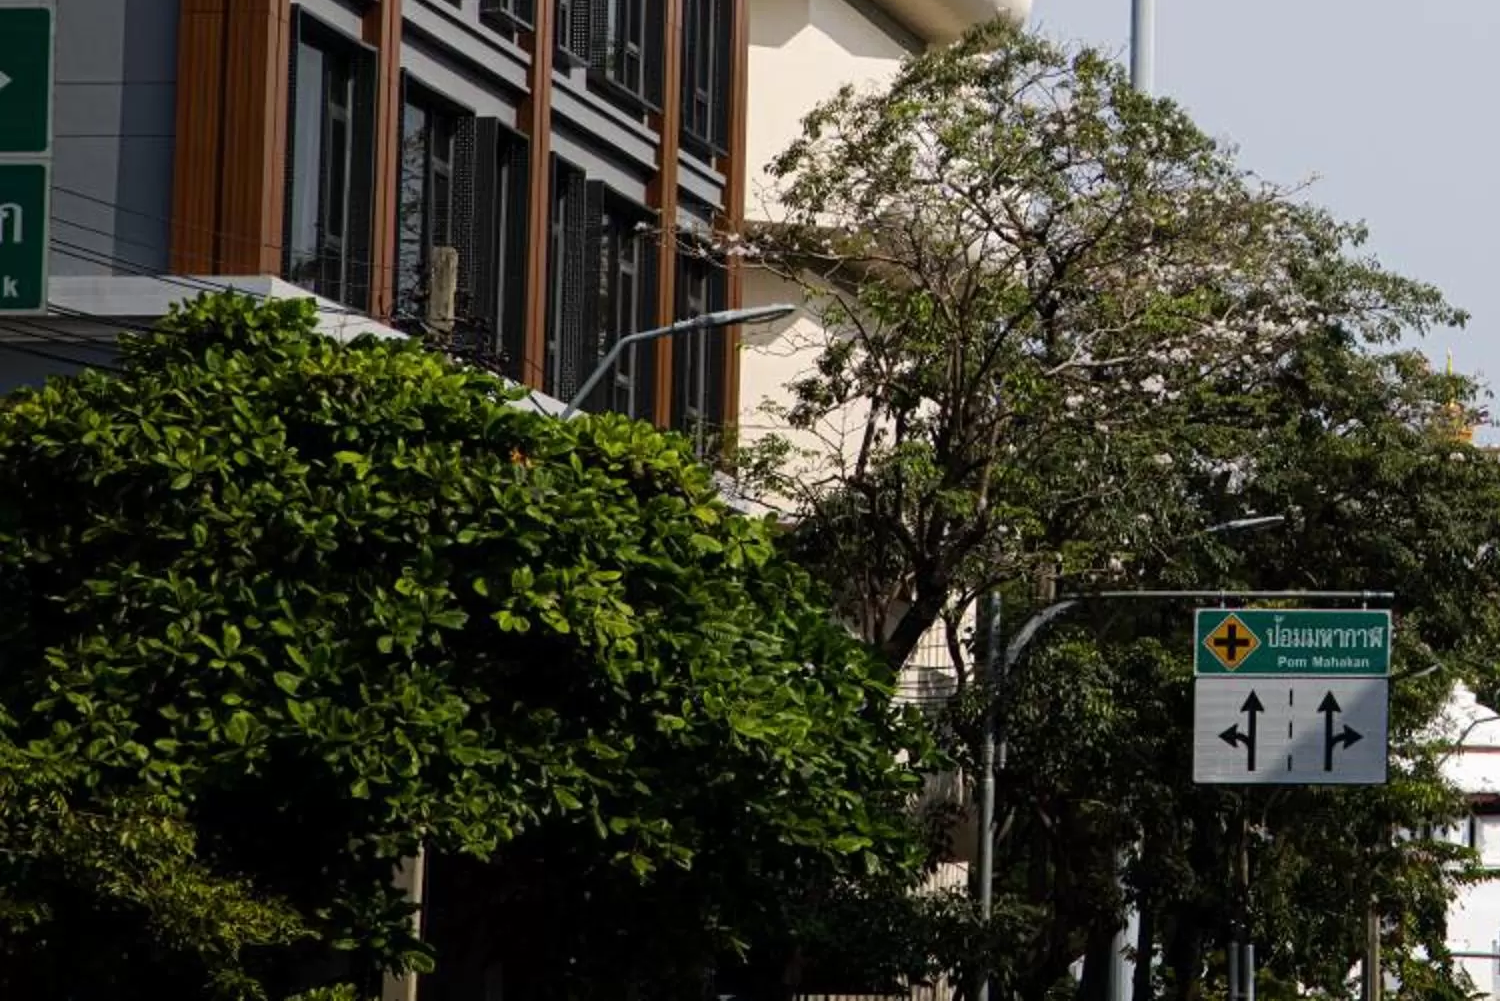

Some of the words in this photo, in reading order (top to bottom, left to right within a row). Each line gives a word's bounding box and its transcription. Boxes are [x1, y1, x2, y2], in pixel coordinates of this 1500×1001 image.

[1266, 614, 1385, 648] ป้อมมหากาฬ
[1277, 655, 1308, 668] Pom
[1311, 655, 1370, 668] Mahakan
